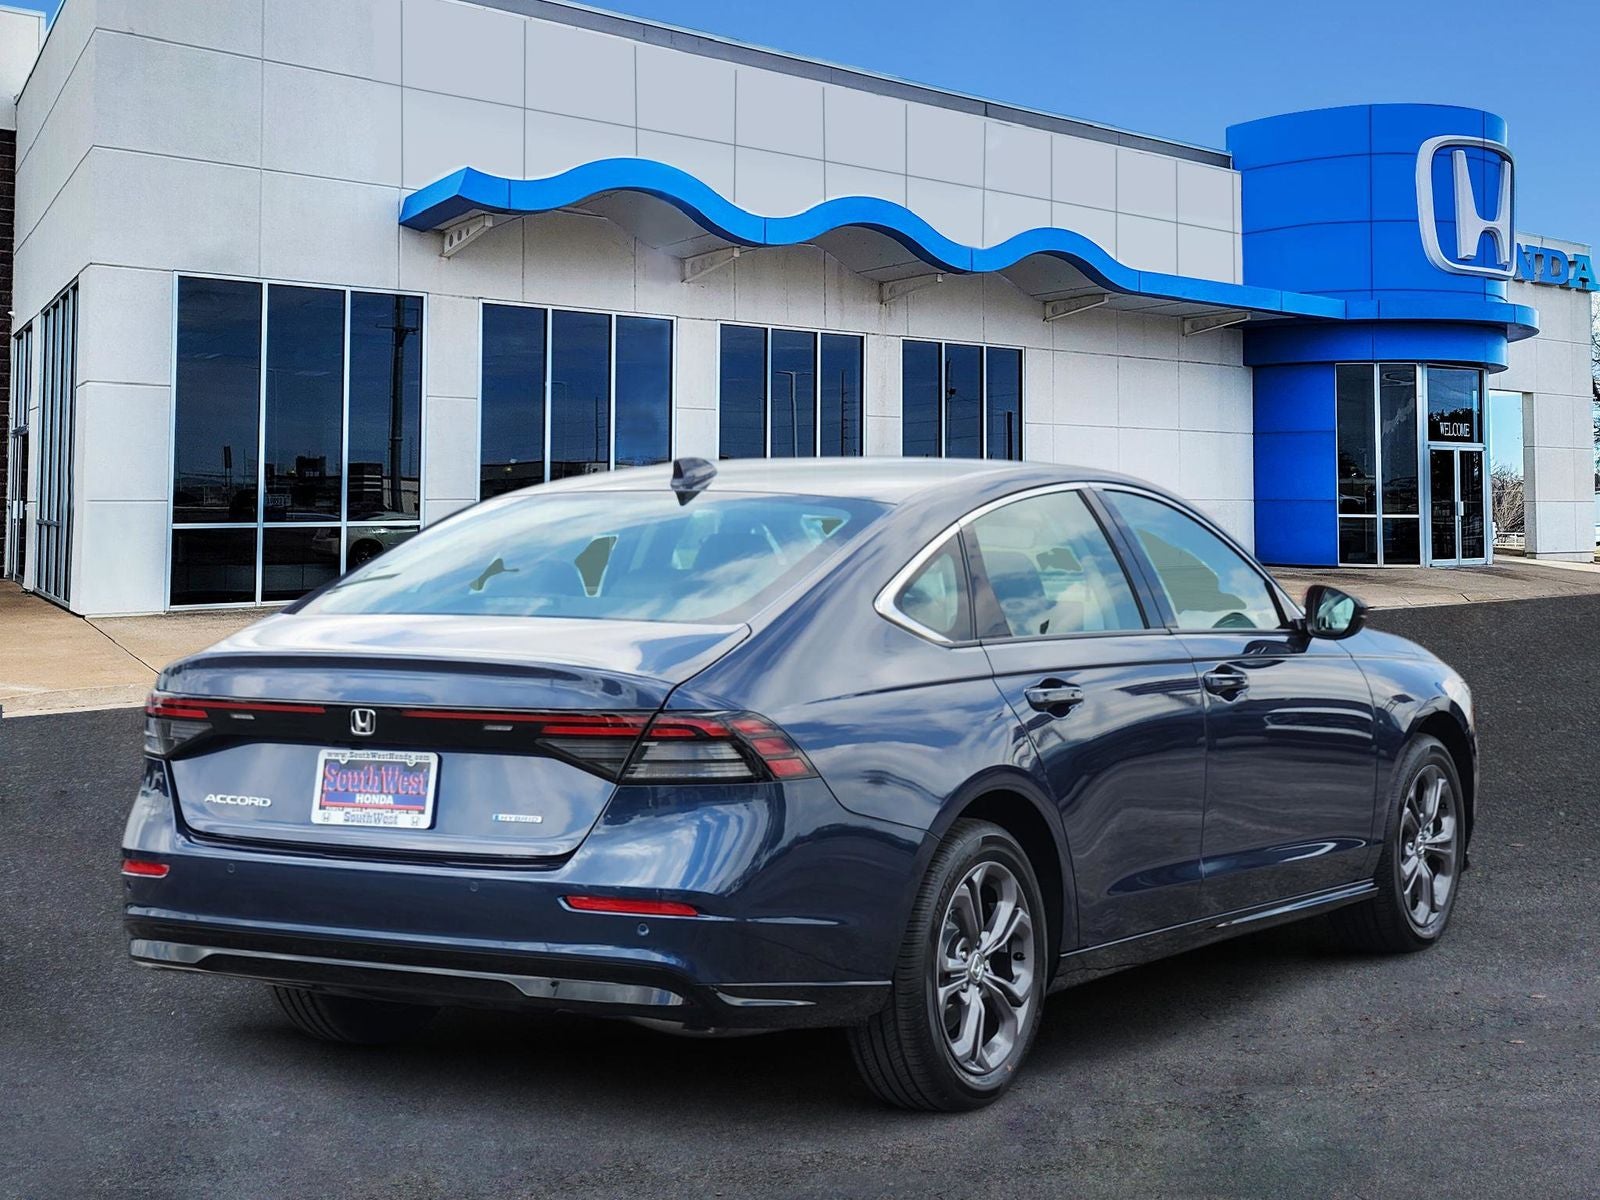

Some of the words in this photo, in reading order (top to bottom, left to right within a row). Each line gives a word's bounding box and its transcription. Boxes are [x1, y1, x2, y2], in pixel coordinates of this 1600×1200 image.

[1439, 422, 1471, 437] WELCOME
[323, 762, 428, 795] SouthWest
[204, 793, 272, 807] ACCORD
[355, 793, 395, 805] HONDA
[343, 811, 399, 825] SouthWest
